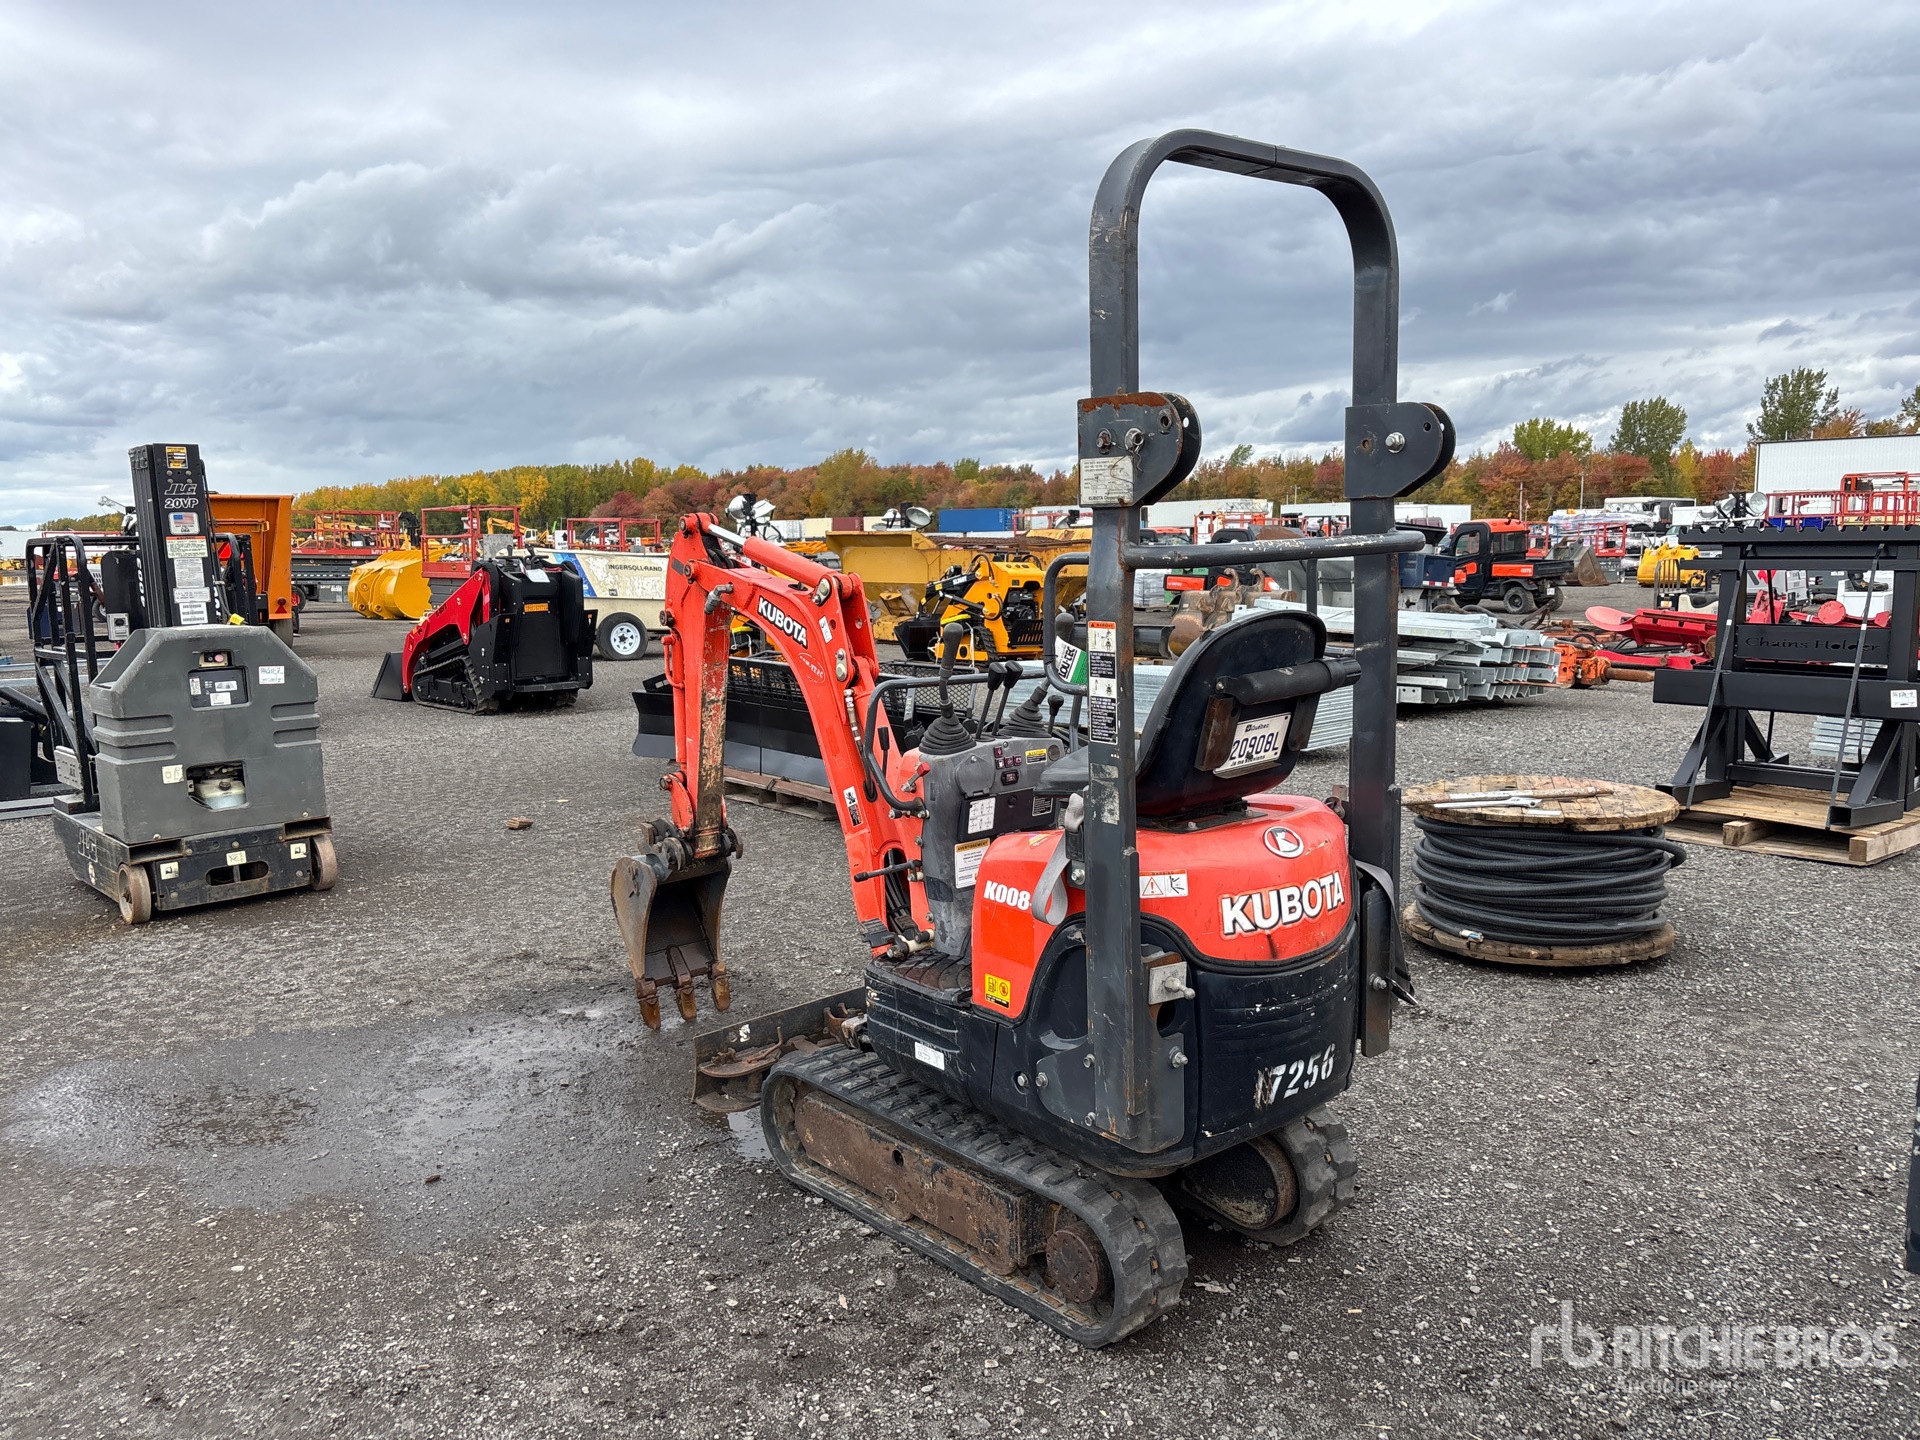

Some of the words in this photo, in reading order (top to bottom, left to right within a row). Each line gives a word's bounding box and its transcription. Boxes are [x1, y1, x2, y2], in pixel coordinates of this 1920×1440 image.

[164, 484, 198, 495] JLG
[164, 498, 199, 509] 20VP
[608, 564, 663, 572] INGERSOLL-RAND
[758, 595, 808, 649] KUBOTA
[1745, 637, 1808, 648] Chains
[1229, 731, 1279, 761] 20908L
[1221, 871, 1345, 935] KUBOTA
